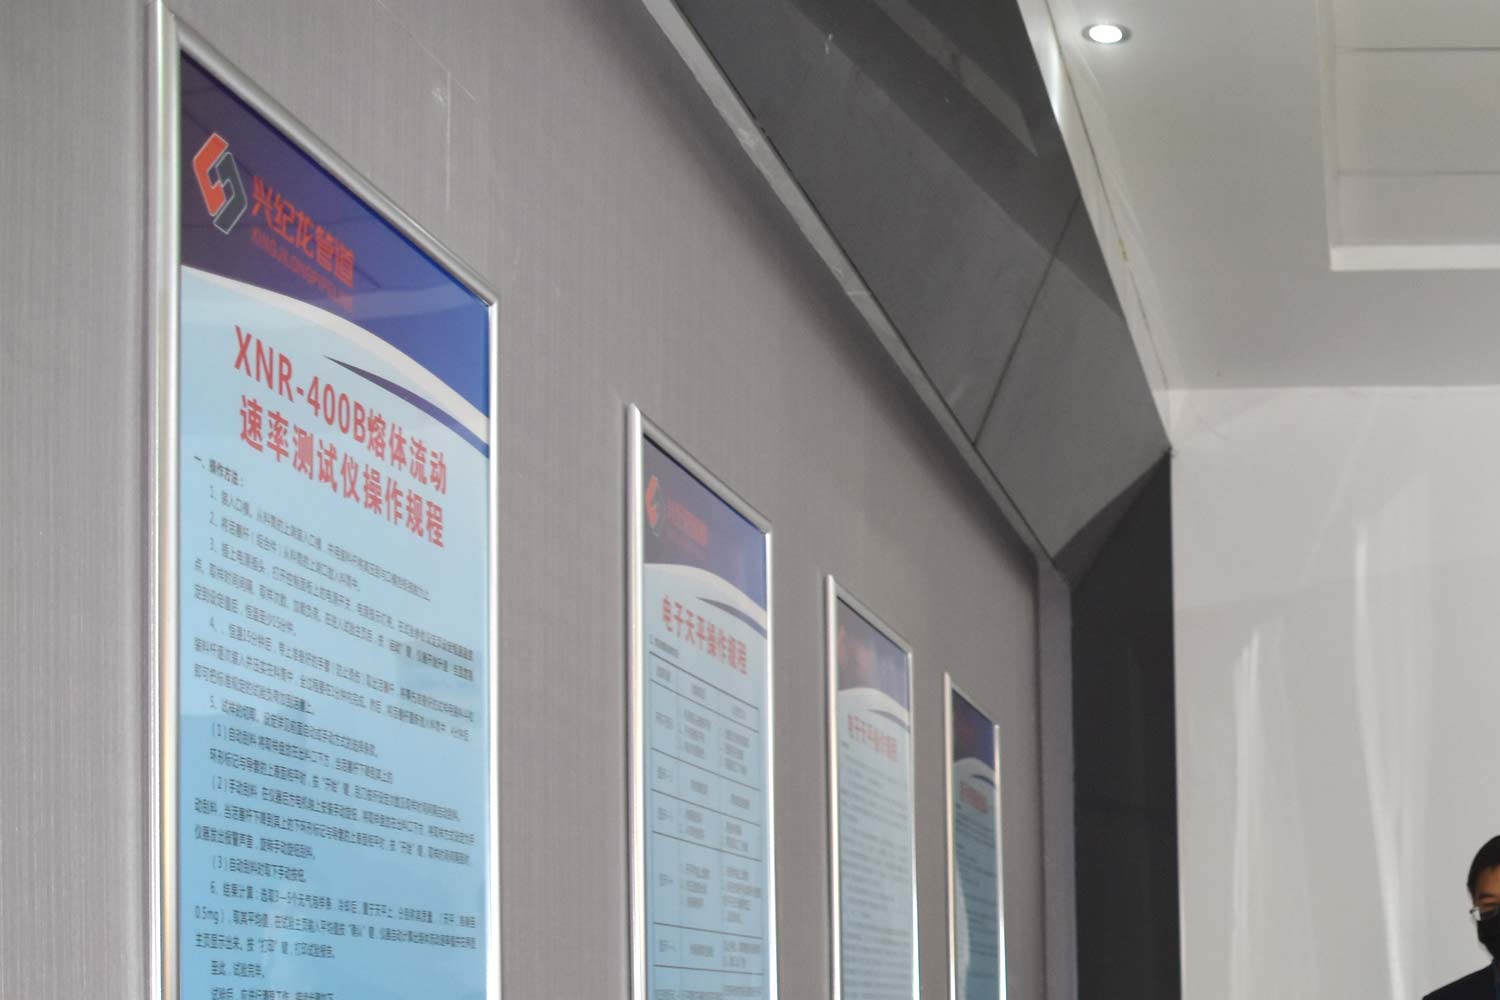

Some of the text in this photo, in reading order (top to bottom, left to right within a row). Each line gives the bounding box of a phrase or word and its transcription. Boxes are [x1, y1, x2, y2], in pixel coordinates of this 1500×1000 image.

[252, 175, 354, 289] 兴纪龙管道
[234, 324, 447, 495] XNR-400B熔体流动
[240, 396, 444, 547] 速率测试仪操作规程
